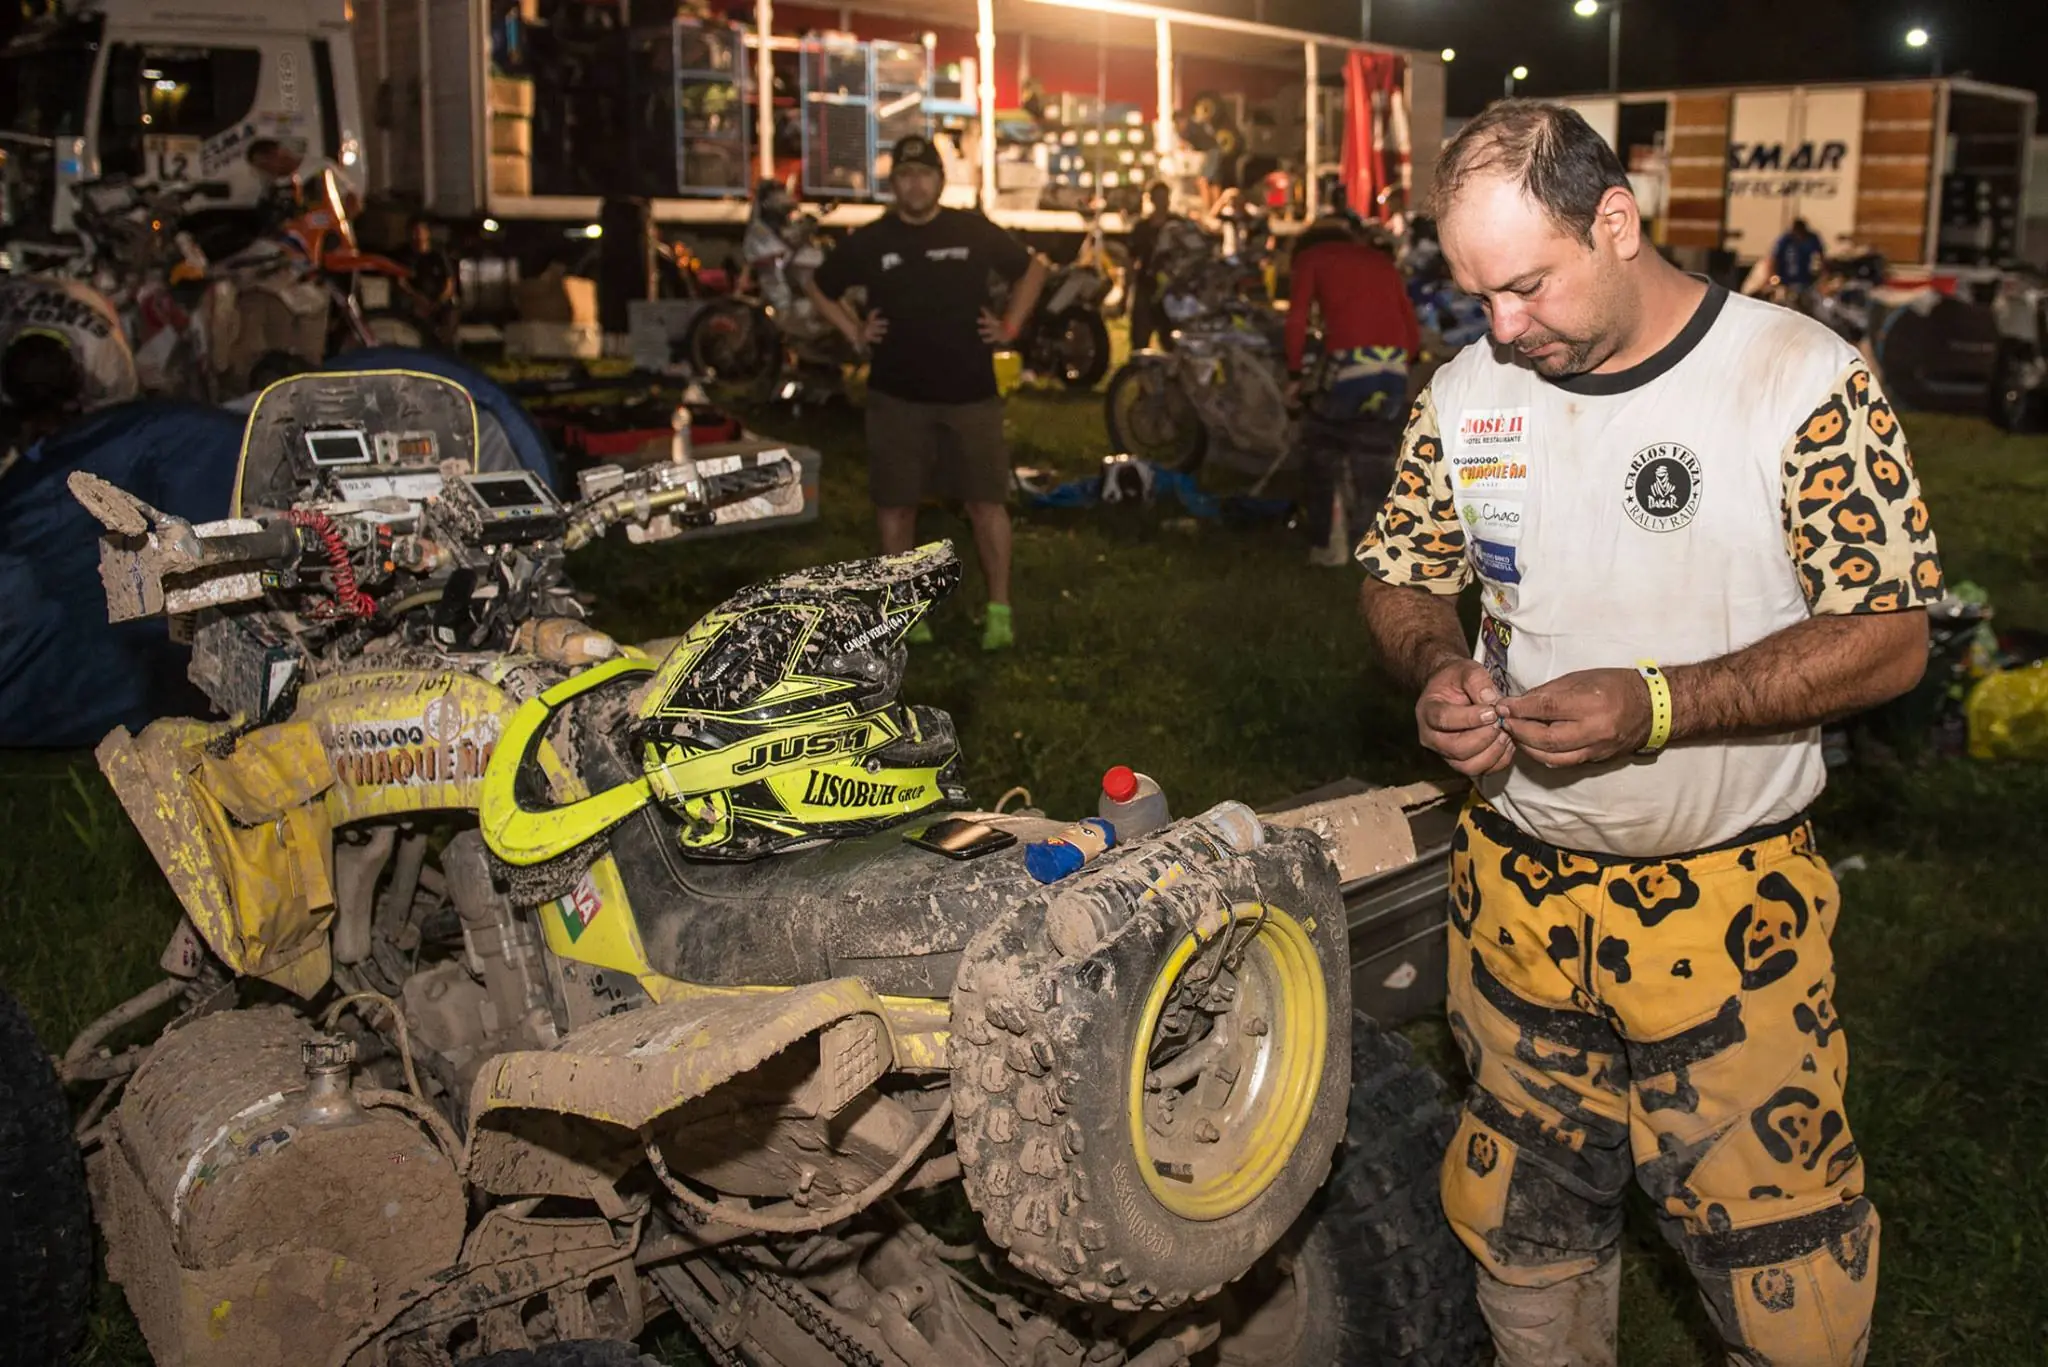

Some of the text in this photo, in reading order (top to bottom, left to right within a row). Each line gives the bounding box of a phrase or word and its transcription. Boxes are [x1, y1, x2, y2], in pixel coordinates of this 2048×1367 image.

[1625, 446, 1701, 490] CARLOS VERZA
[1482, 503, 1520, 523] Chaco
[1629, 500, 1696, 529] RALLY RAID
[1647, 494, 1679, 509] DAKAR
[843, 630, 870, 653] CARLOS
[867, 622, 891, 640] VERZA
[801, 768, 926, 808] LISOBUH GRUP
